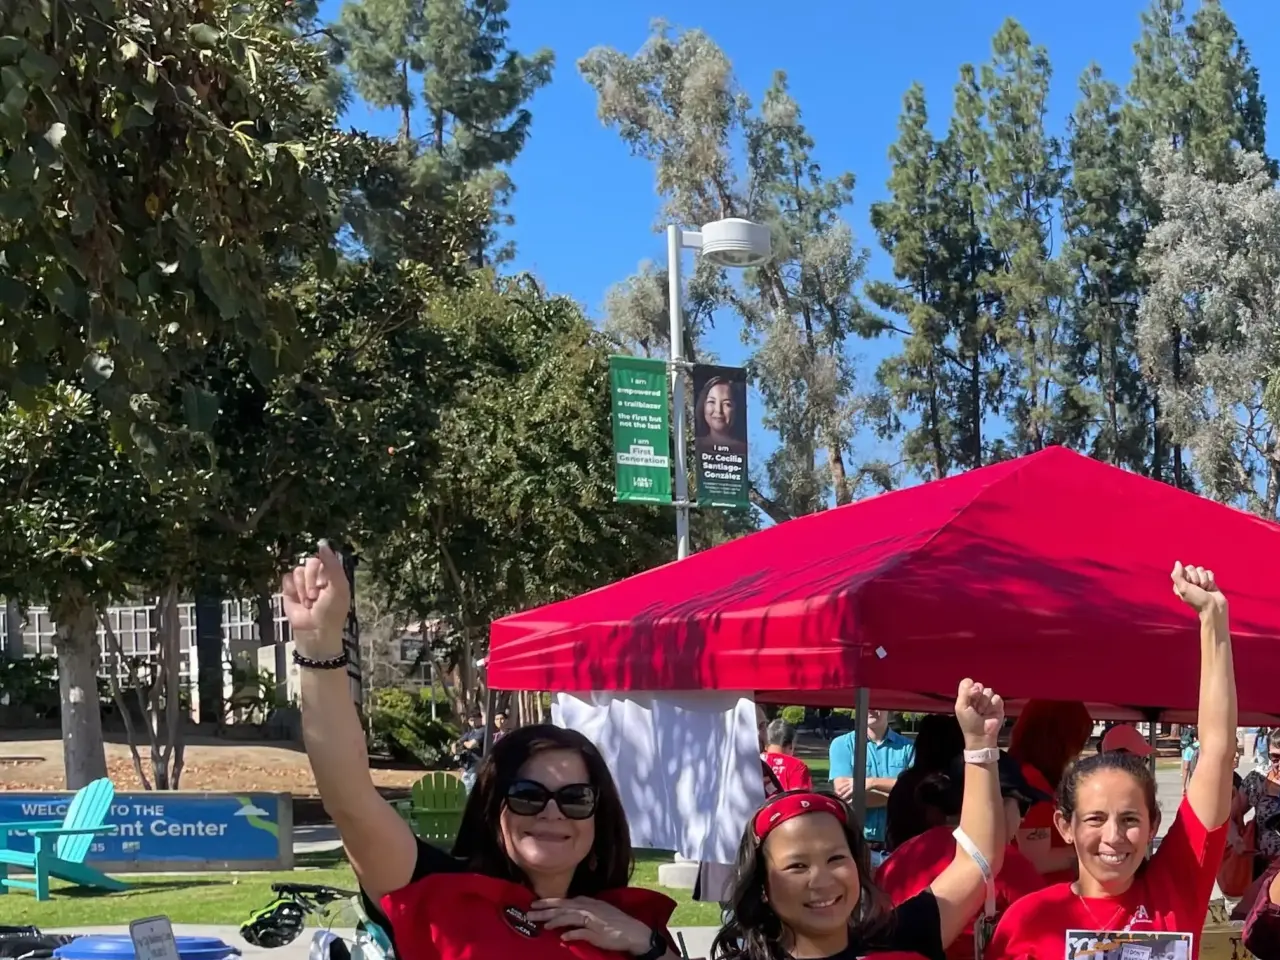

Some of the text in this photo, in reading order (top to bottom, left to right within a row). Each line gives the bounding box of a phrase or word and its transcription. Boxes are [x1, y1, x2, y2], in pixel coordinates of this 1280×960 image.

[617, 388, 661, 396] empowered
[624, 400, 662, 410] trailblazer
[632, 414, 648, 422] first
[620, 454, 666, 464] Generation
[702, 452, 742, 463] Dr. Cecilia
[702, 462, 742, 472] Santiago-
[704, 470, 741, 480] González
[111, 804, 129, 816] TO
[133, 805, 164, 816] THE
[150, 820, 228, 836] Center
